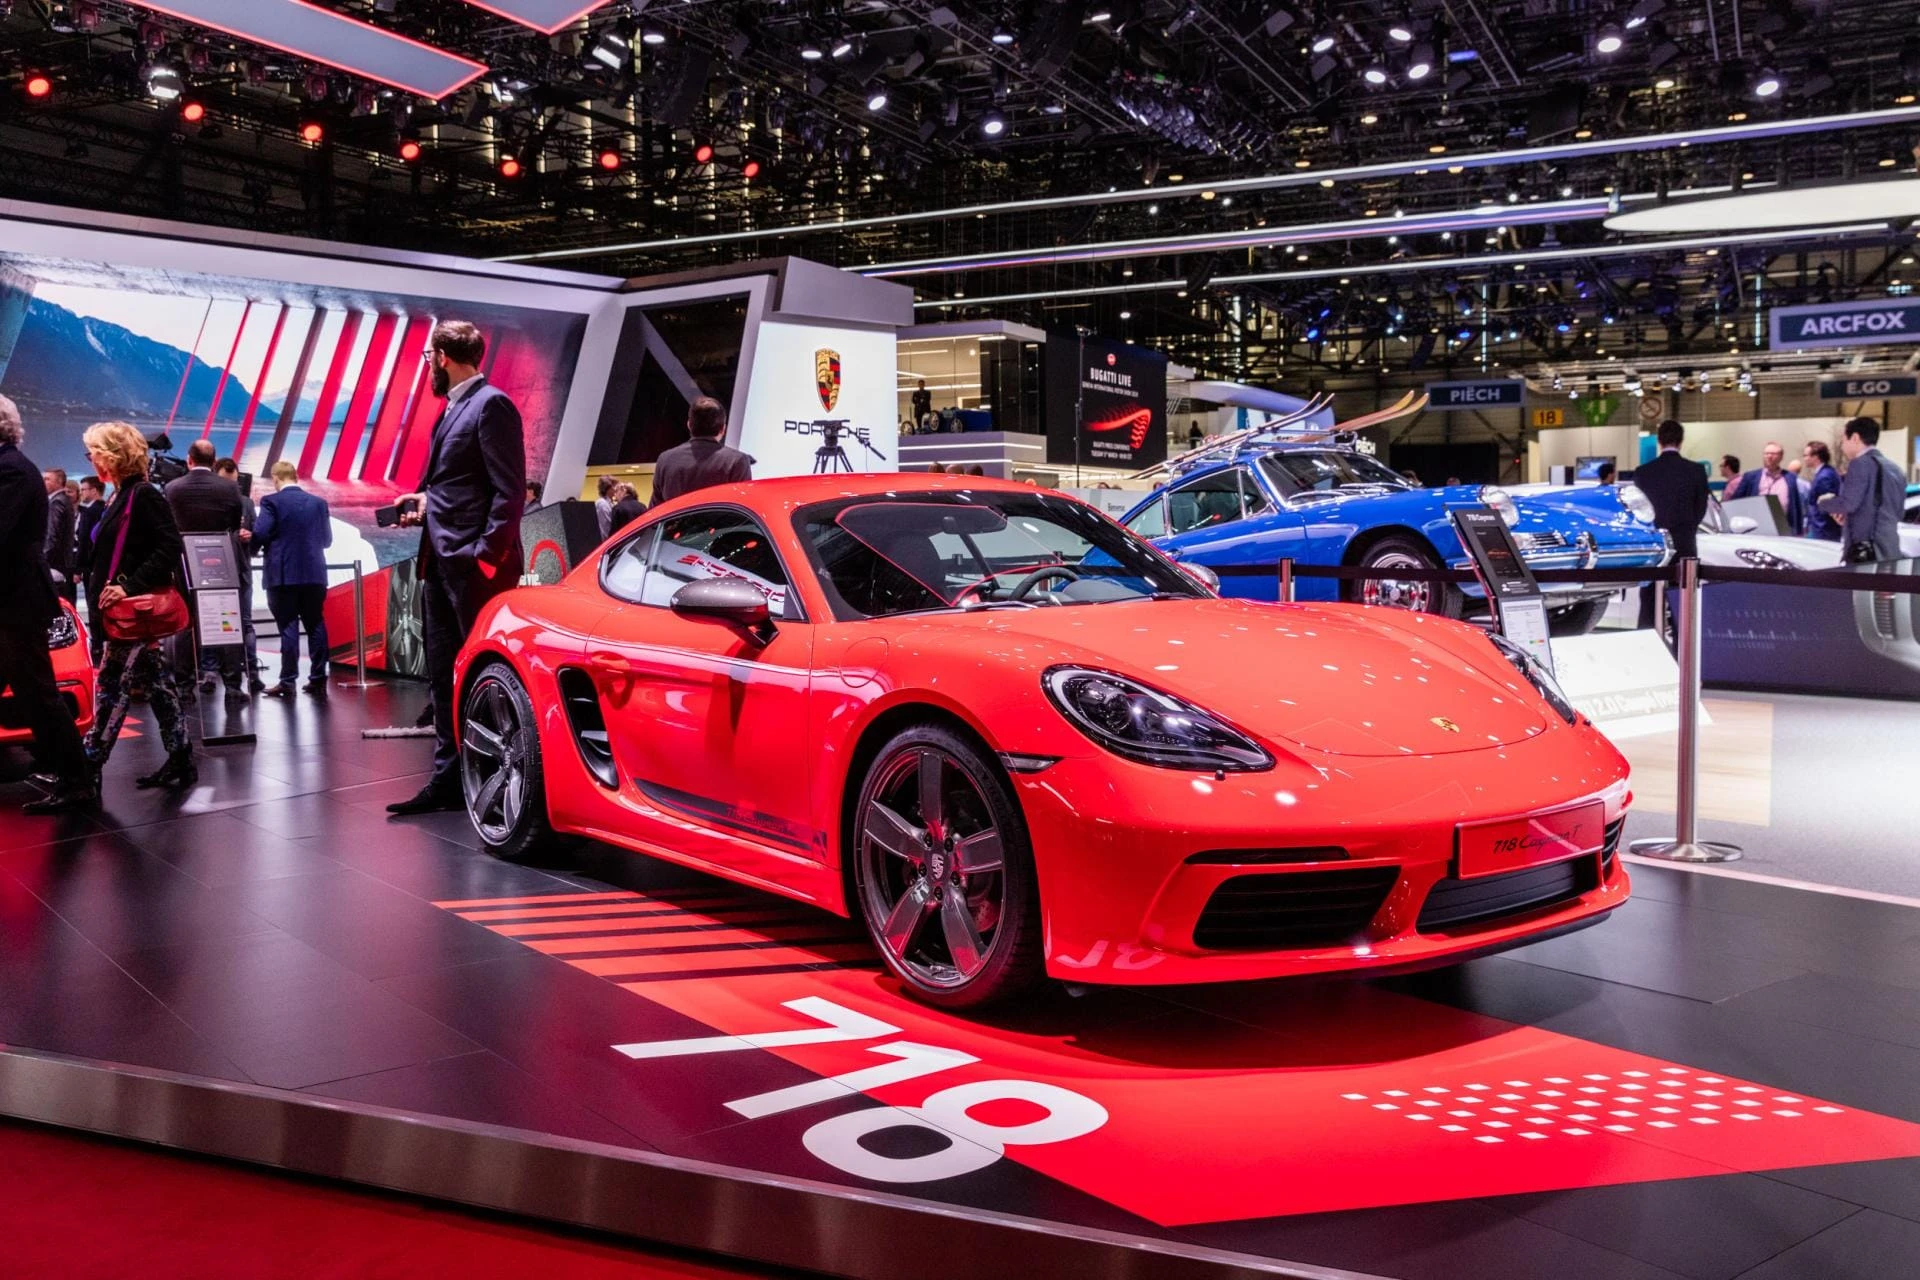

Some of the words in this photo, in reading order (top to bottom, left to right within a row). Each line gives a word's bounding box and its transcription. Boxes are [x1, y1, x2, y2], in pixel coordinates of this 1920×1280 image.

[1800, 311, 1905, 335] ARCFOX
[1090, 367, 1117, 384] BUGATTI
[1118, 373, 1132, 387] LIVE
[1450, 386, 1500, 402] PIËCH
[1846, 381, 1891, 395] E.GO
[1540, 411, 1555, 424] 18
[784, 420, 870, 441] PORHE
[1493, 837, 1518, 854] 718
[1573, 823, 1582, 838] T
[610, 996, 1109, 1183] 718
